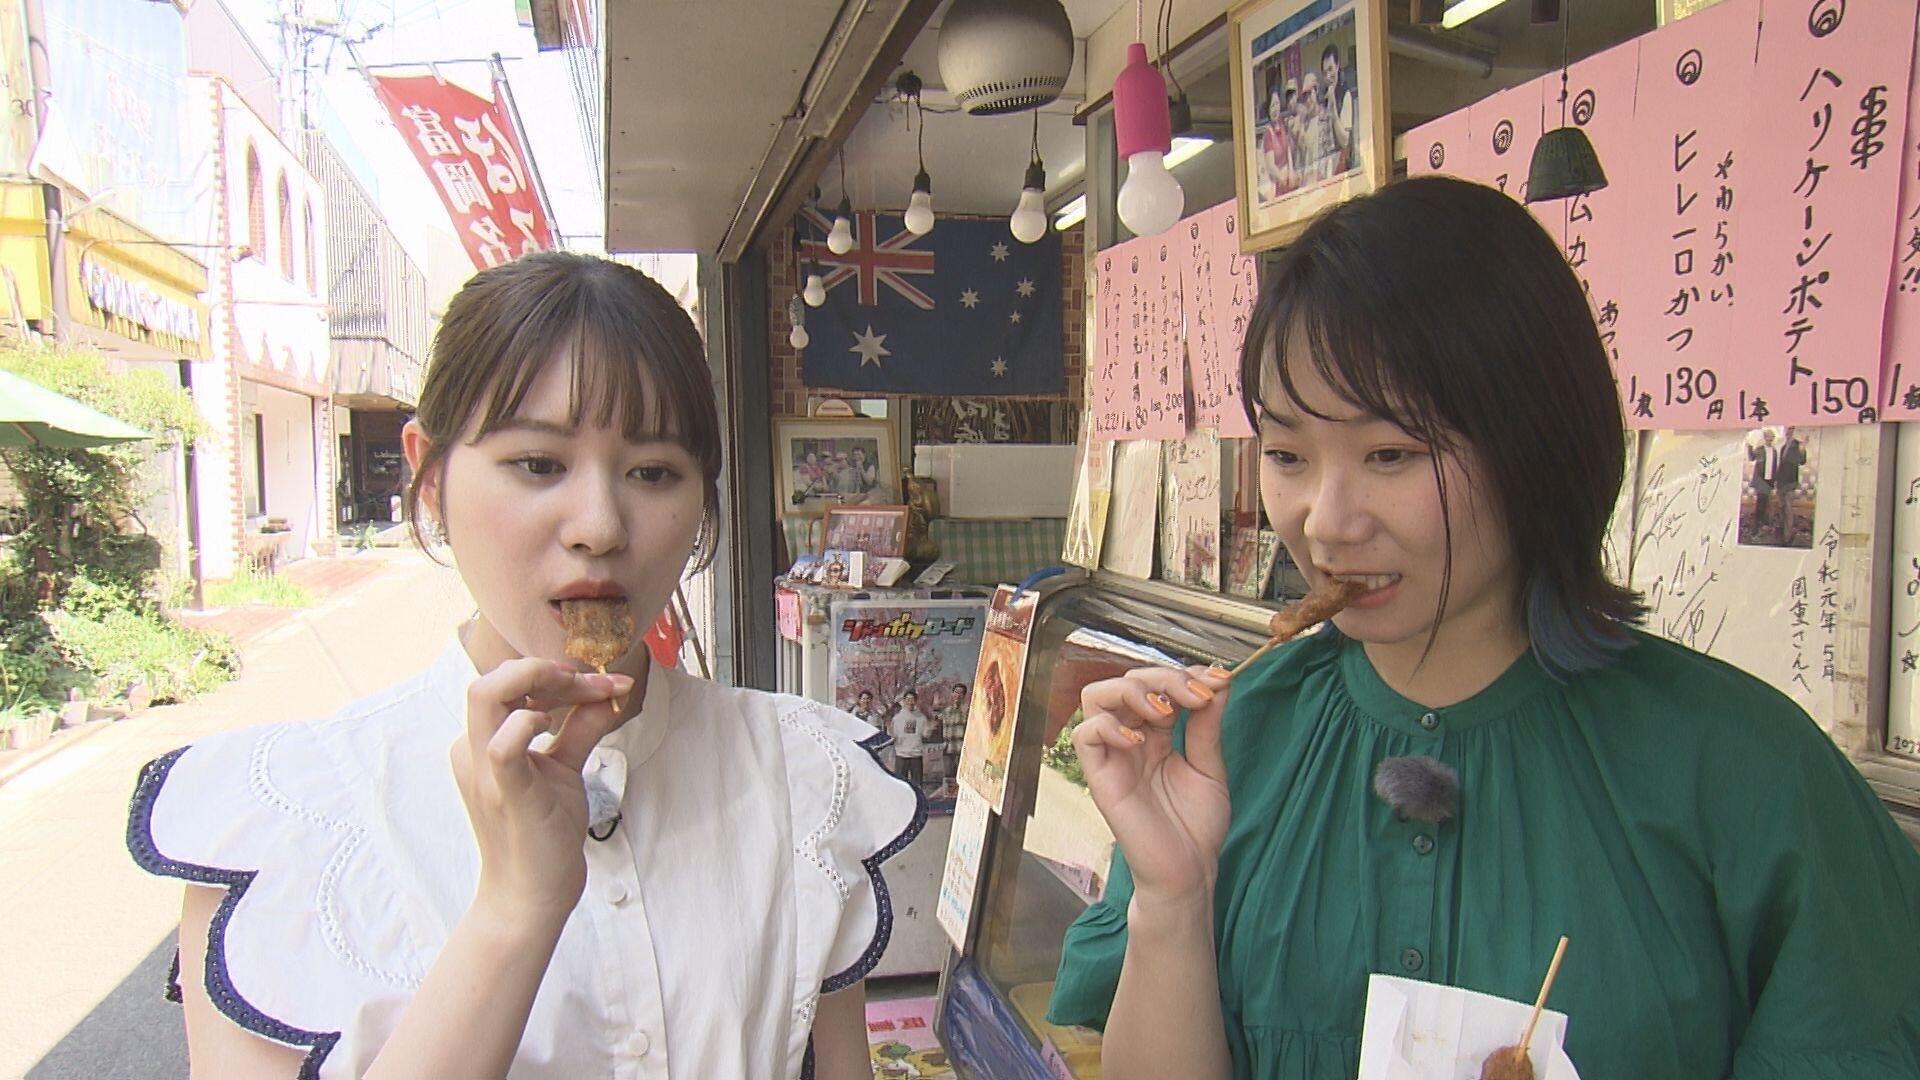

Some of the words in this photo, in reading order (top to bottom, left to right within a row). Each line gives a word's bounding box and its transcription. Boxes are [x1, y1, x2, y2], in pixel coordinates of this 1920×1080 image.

[1782, 67, 1843, 386] ハリケーンポテト
[1664, 366, 1724, 420] 130円
[1739, 390, 1770, 421] 1本
[1810, 376, 1878, 423] 150円
